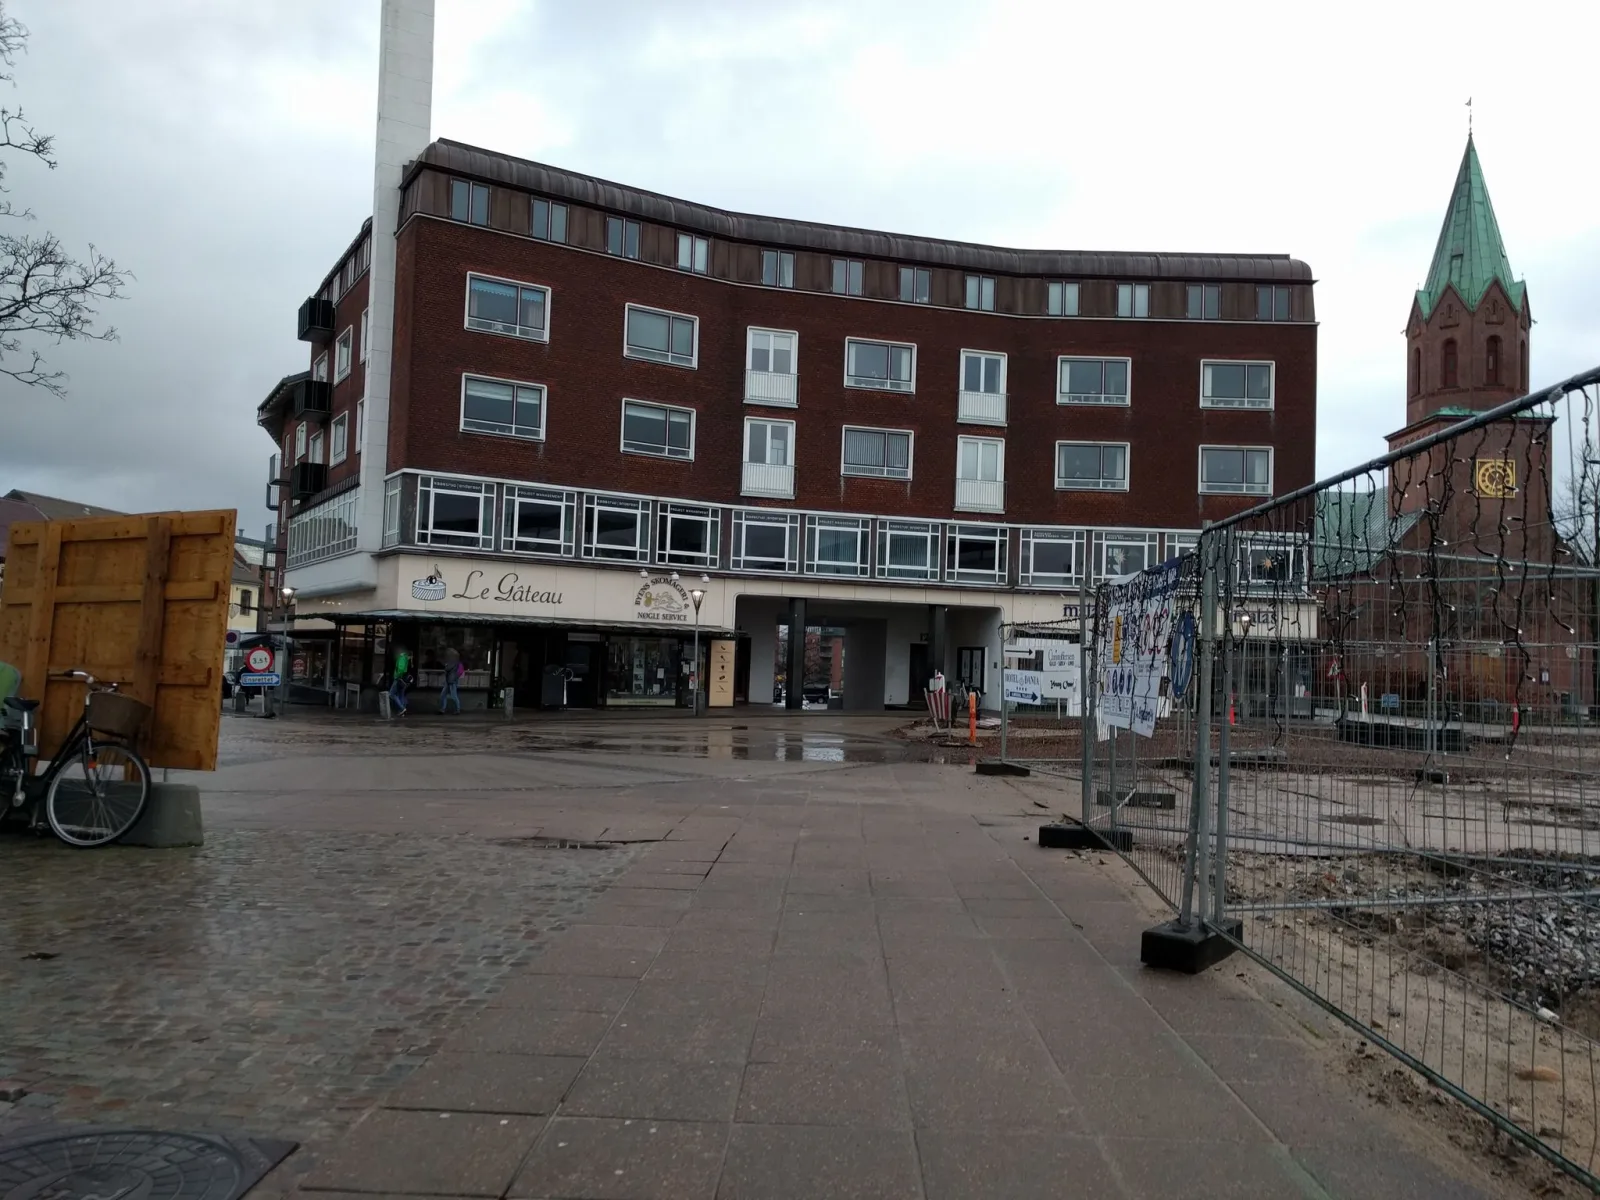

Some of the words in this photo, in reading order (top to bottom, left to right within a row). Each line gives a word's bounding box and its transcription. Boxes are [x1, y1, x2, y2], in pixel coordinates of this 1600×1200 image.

[452, 570, 489, 599] Le
[494, 573, 562, 604] Gâteau
[635, 582, 650, 605] BYENS
[650, 577, 688, 601] SKOMAGERI
[637, 612, 660, 620] NØGLE
[661, 613, 688, 621] SERVICE
[1005, 673, 1018, 684] HOTEL
[1024, 675, 1039, 686] DANIA
